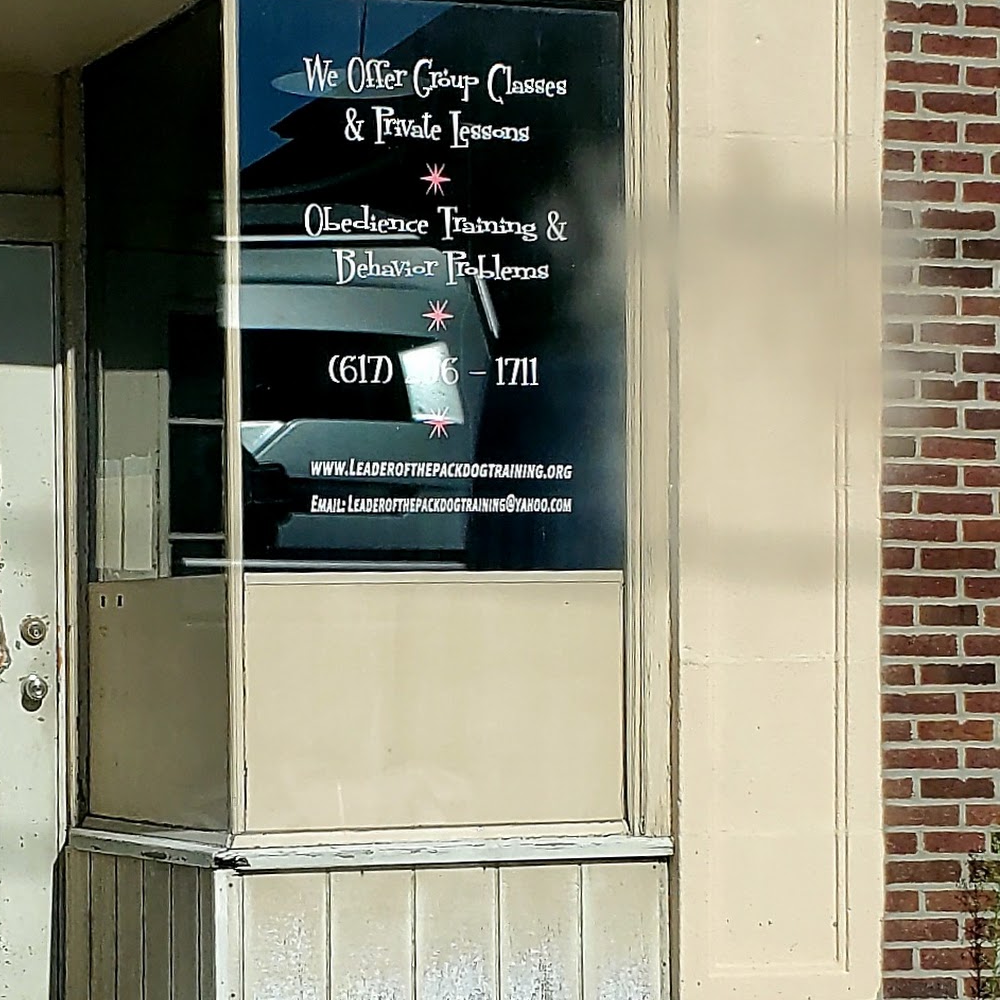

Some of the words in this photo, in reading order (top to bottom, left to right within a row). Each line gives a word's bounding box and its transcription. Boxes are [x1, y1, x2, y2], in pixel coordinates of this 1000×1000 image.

[303, 54, 339, 92] We
[347, 57, 408, 94] Offer
[413, 58, 480, 103] Group
[487, 63, 567, 105] Classes
[344, 107, 365, 142] &
[371, 106, 442, 145] Private
[449, 110, 530, 149] Lessons
[304, 203, 430, 237] Obedience
[437, 206, 538, 241] Training
[546, 210, 568, 242] &
[333, 249, 439, 286] Behavior
[442, 250, 550, 287] Problems
[328, 354, 393, 384] (617)
[495, 356, 539, 386] 1711
